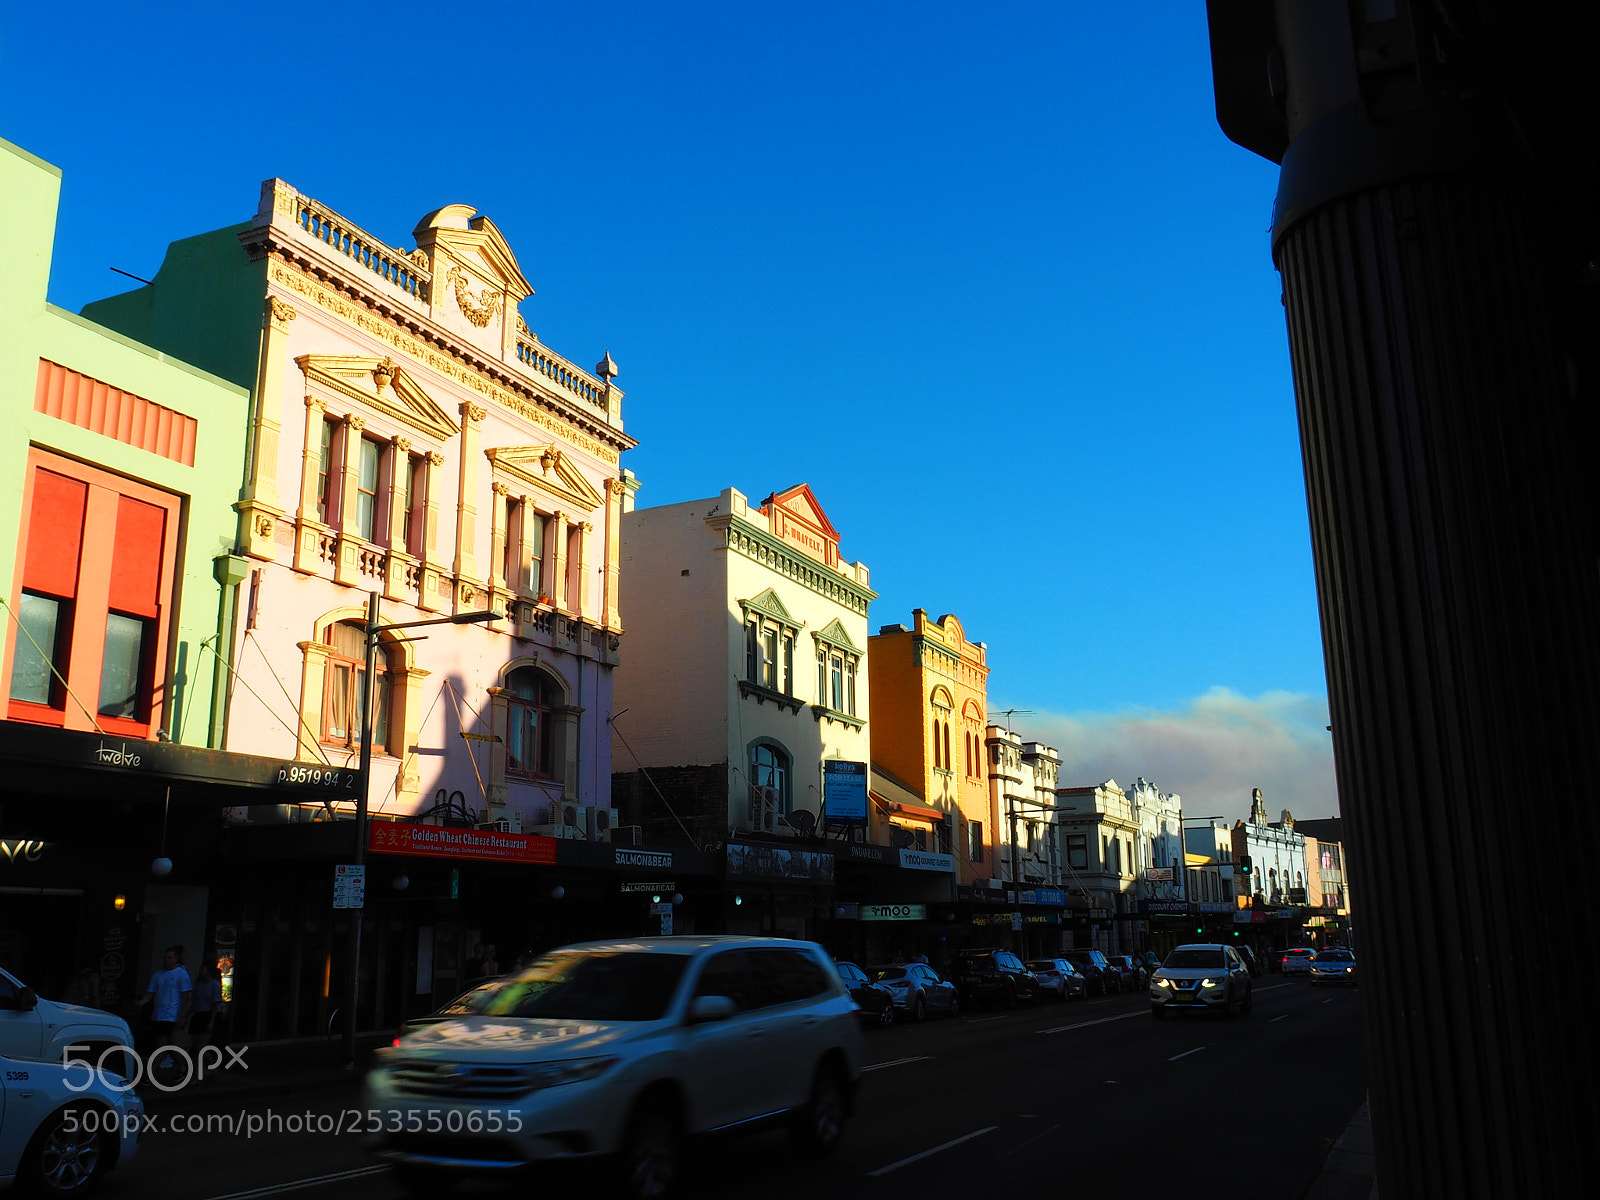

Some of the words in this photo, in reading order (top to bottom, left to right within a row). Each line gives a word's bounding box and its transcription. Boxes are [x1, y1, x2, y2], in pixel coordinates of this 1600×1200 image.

[95, 739, 142, 767] twelve
[277, 766, 322, 784] p.9519
[412, 828, 438, 842] Golden
[439, 830, 462, 844] Wheat
[463, 833, 490, 846] Chinese
[490, 835, 528, 849] Restaurant
[615, 852, 673, 868] SALMON&BEAR
[620, 883, 676, 892] SALMON&BEAR
[6, 1071, 29, 1081] 5389
